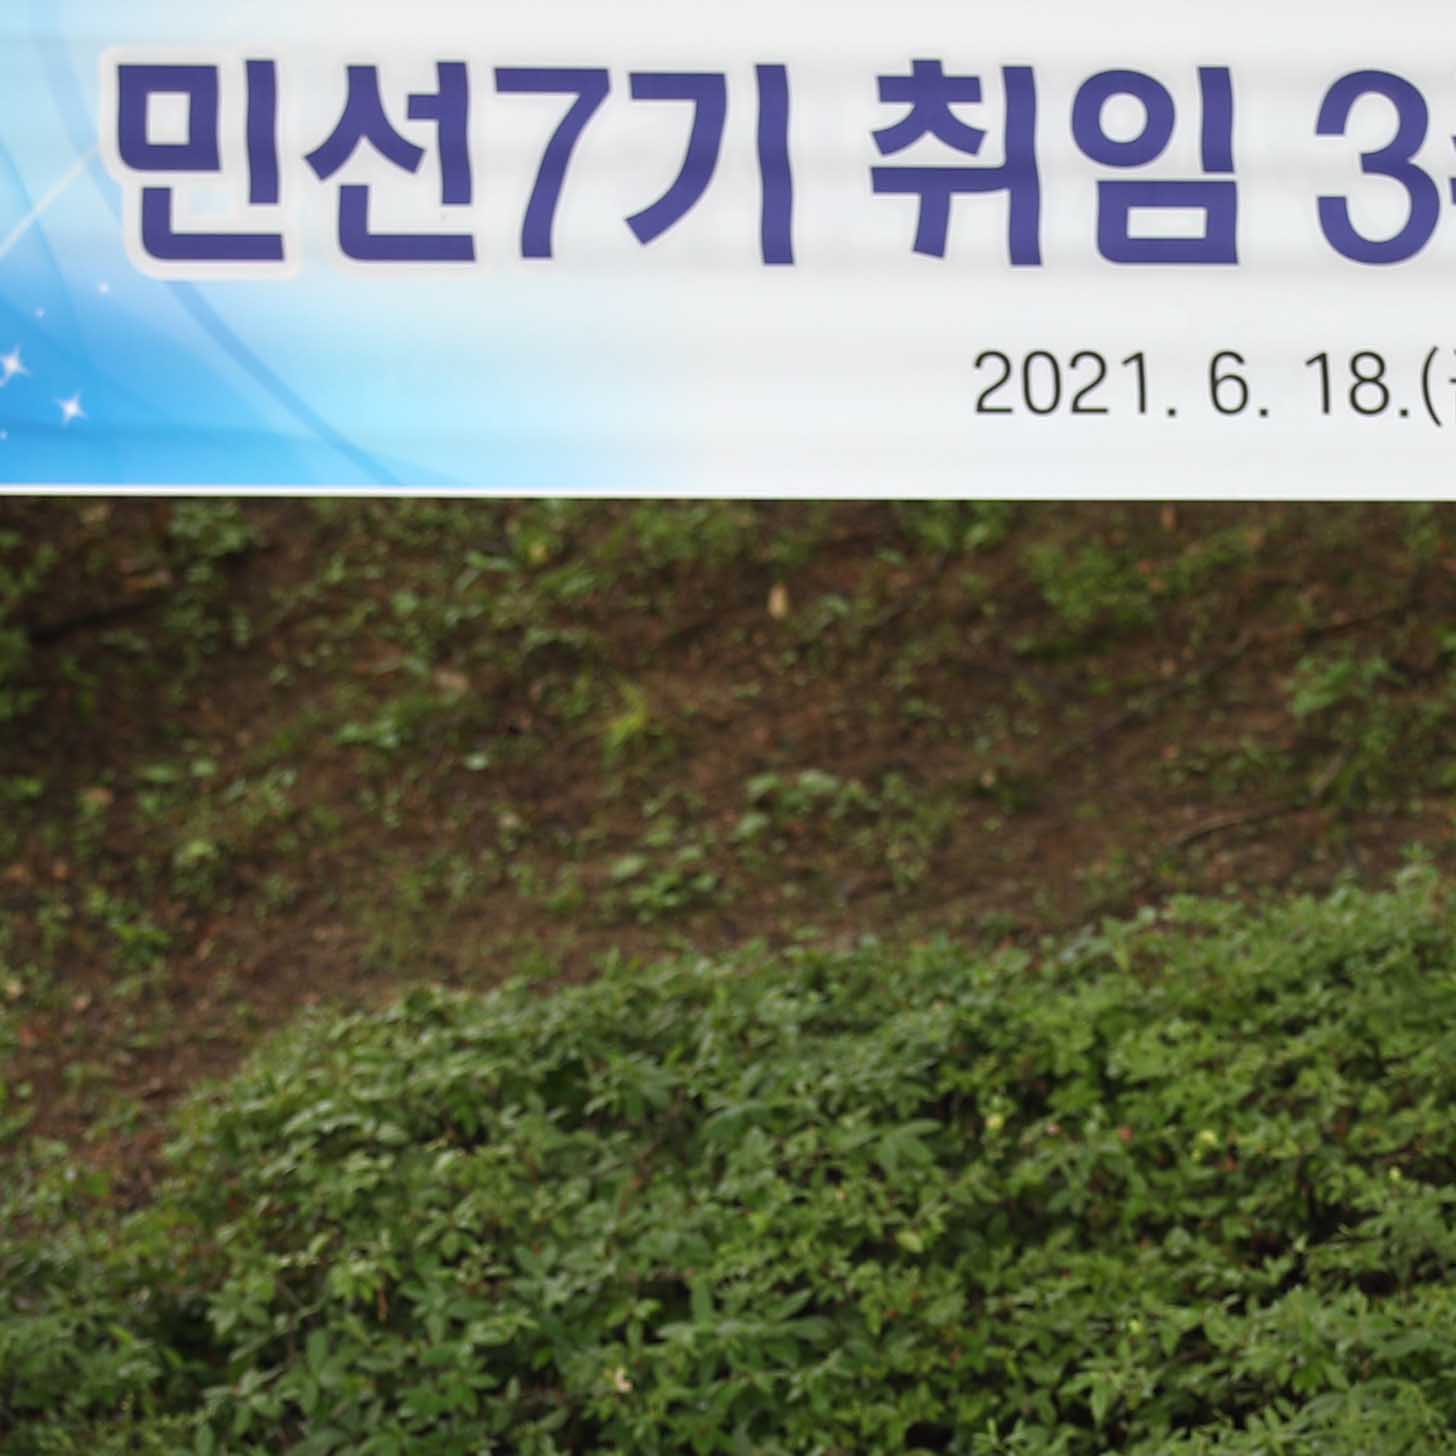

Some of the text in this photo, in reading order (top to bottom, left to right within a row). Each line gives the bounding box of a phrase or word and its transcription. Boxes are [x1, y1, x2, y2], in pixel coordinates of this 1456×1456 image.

[117, 59, 795, 266] 민선7기
[870, 59, 1240, 267] 취임
[974, 350, 1177, 418] 2021.
[1209, 350, 1269, 418] 6.
